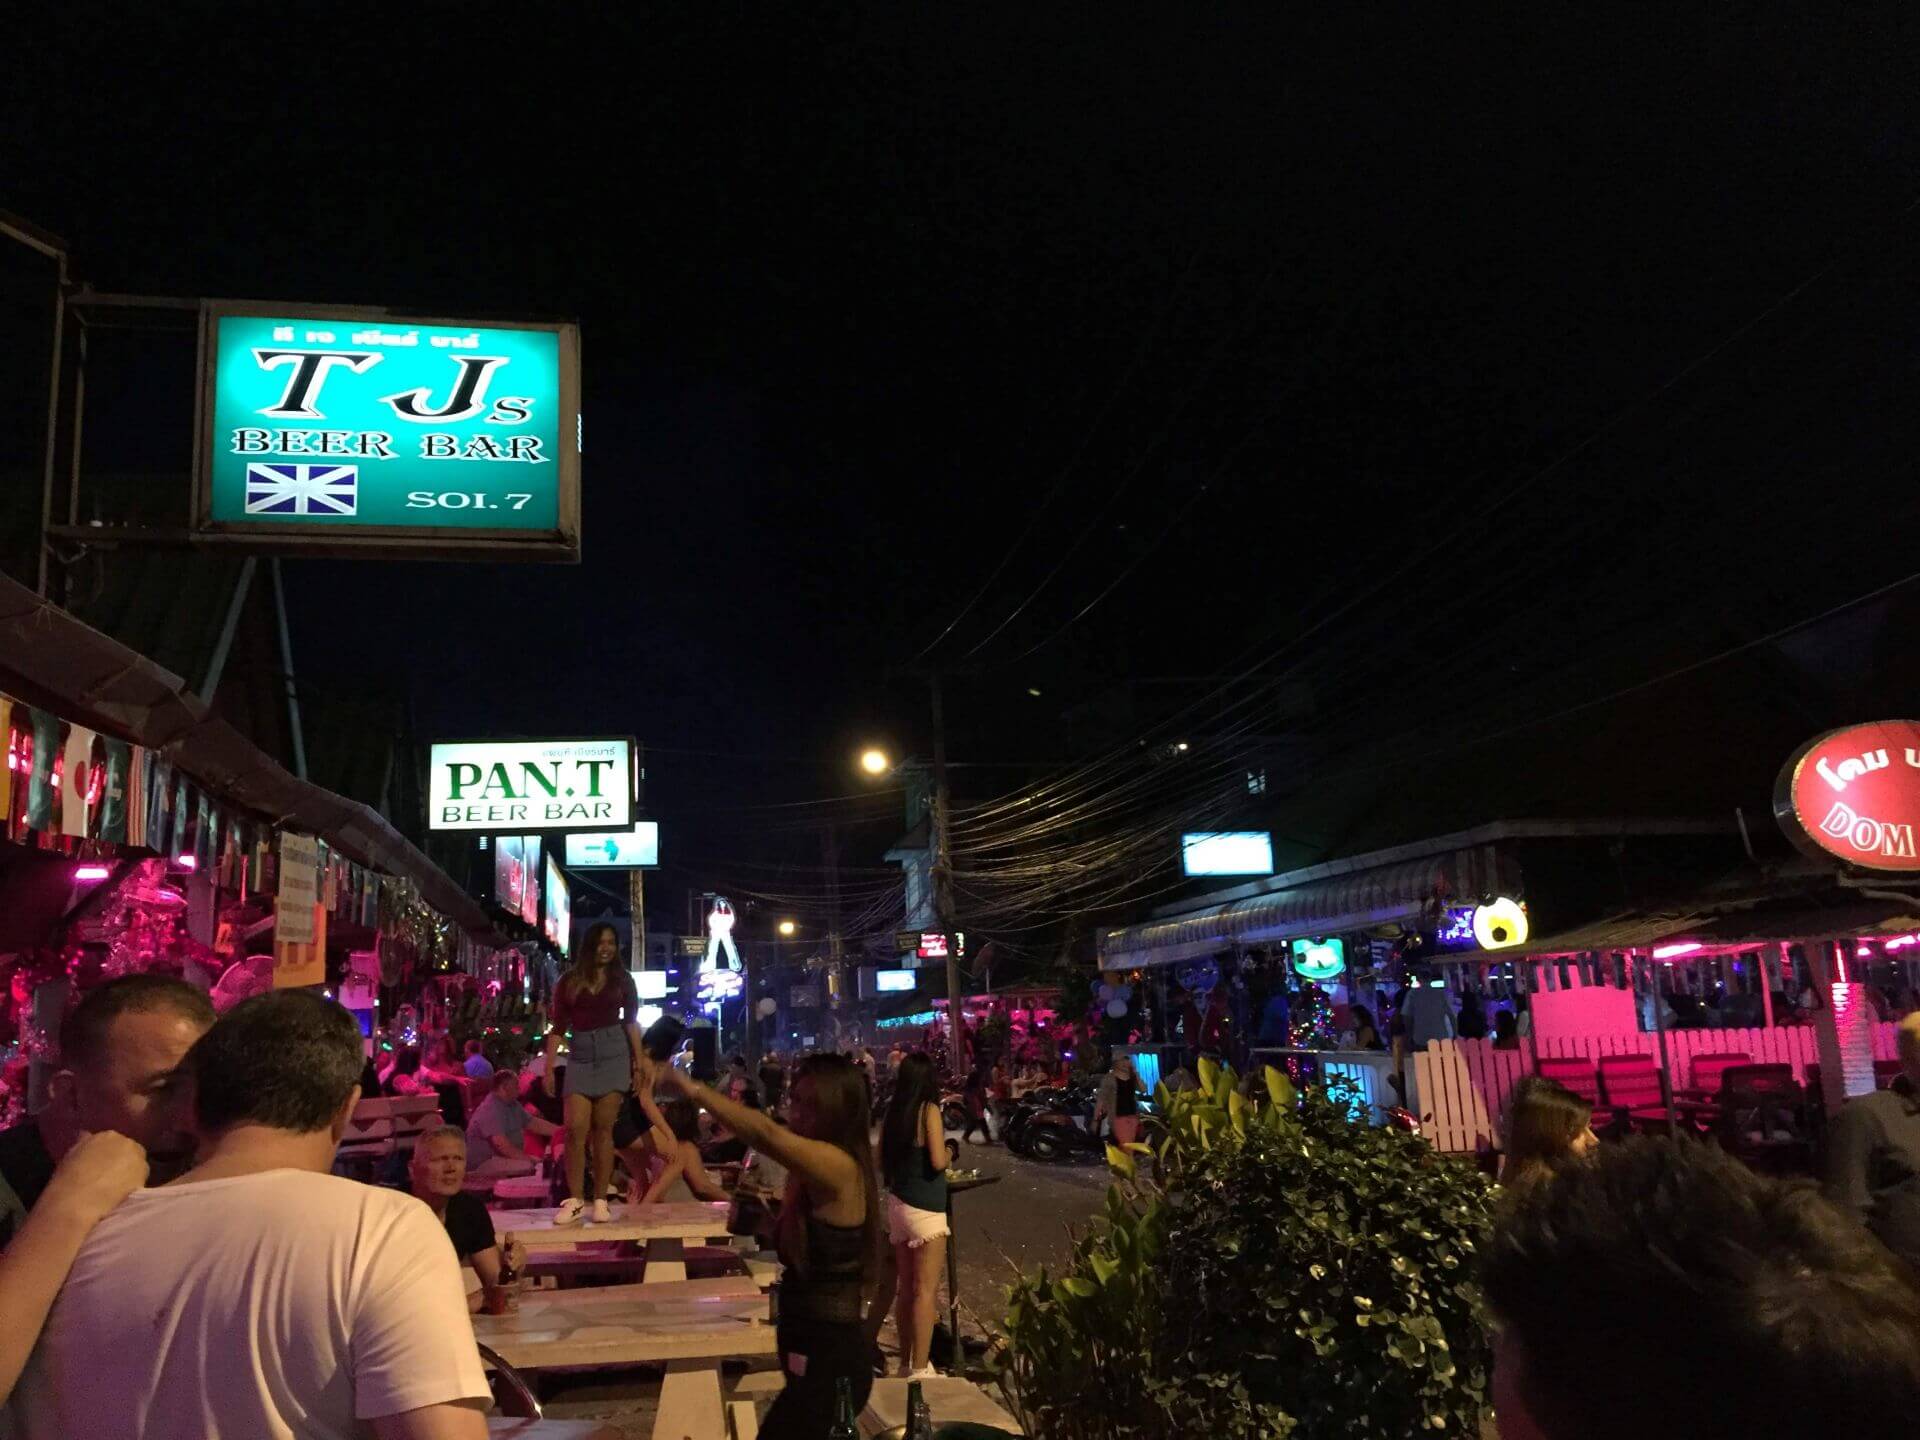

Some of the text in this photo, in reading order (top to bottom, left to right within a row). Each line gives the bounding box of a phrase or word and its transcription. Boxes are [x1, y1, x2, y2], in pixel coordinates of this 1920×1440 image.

[234, 429, 547, 463] BEER BAR
[445, 759, 615, 800] PAN.T
[442, 802, 612, 823] BEER BAR
